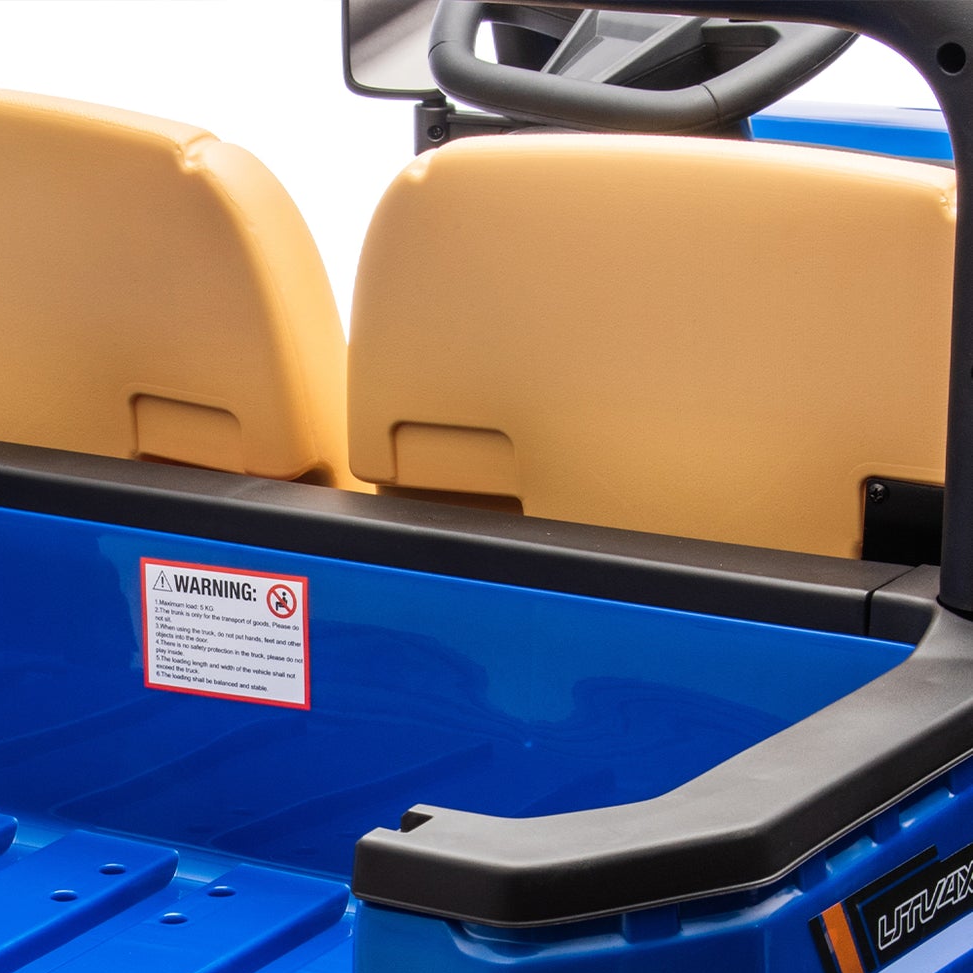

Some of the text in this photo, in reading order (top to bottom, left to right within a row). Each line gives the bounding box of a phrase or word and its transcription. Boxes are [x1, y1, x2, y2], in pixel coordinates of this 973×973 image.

[174, 574, 257, 602] WARNING:
[172, 657, 191, 666] loading
[214, 679, 238, 687] balanced
